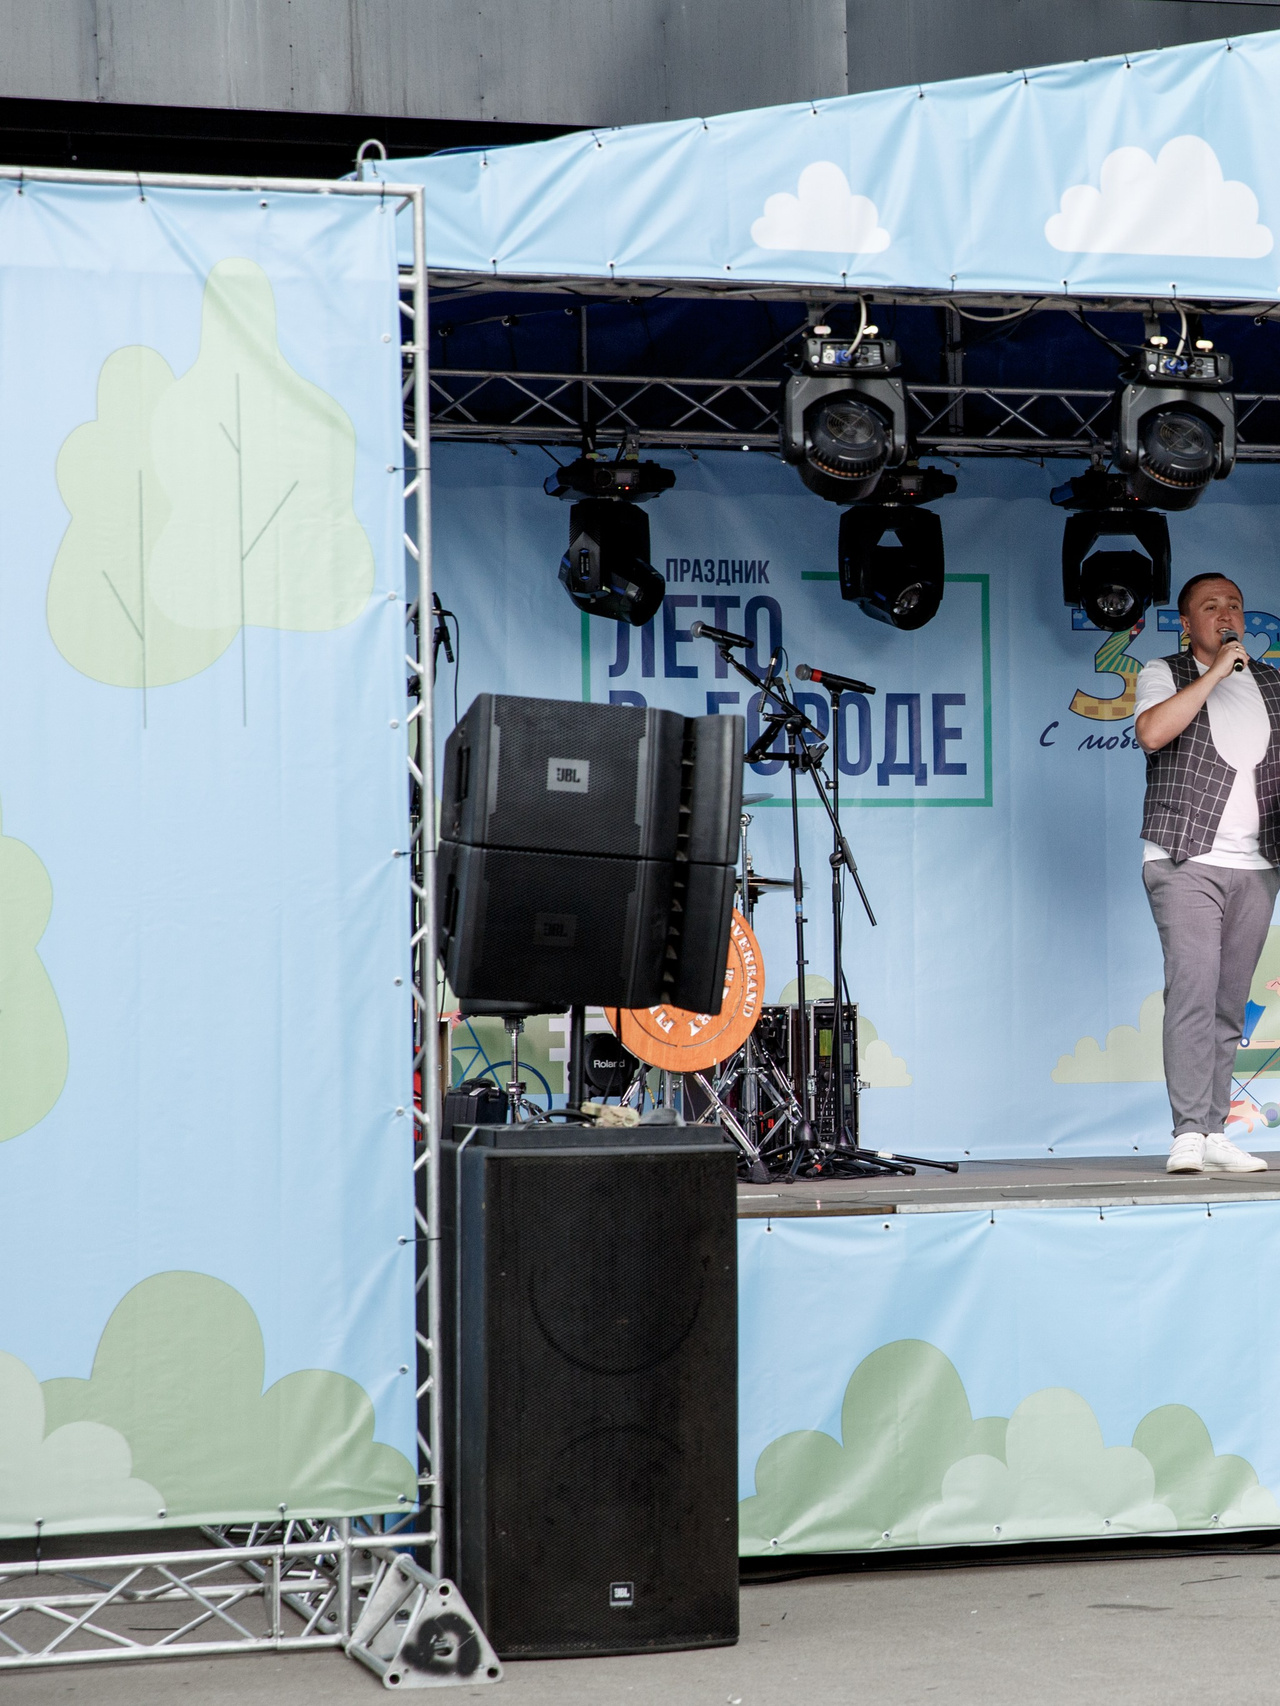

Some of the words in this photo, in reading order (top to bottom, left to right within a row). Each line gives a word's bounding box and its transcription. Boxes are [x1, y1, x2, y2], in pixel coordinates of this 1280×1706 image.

[665, 557, 770, 585] ПРАЗДНИК
[608, 594, 783, 679] ЛЕТО
[706, 691, 968, 787] ОРОДЕ
[556, 766, 581, 783] JBL
[613, 1587, 630, 1599] JBL
